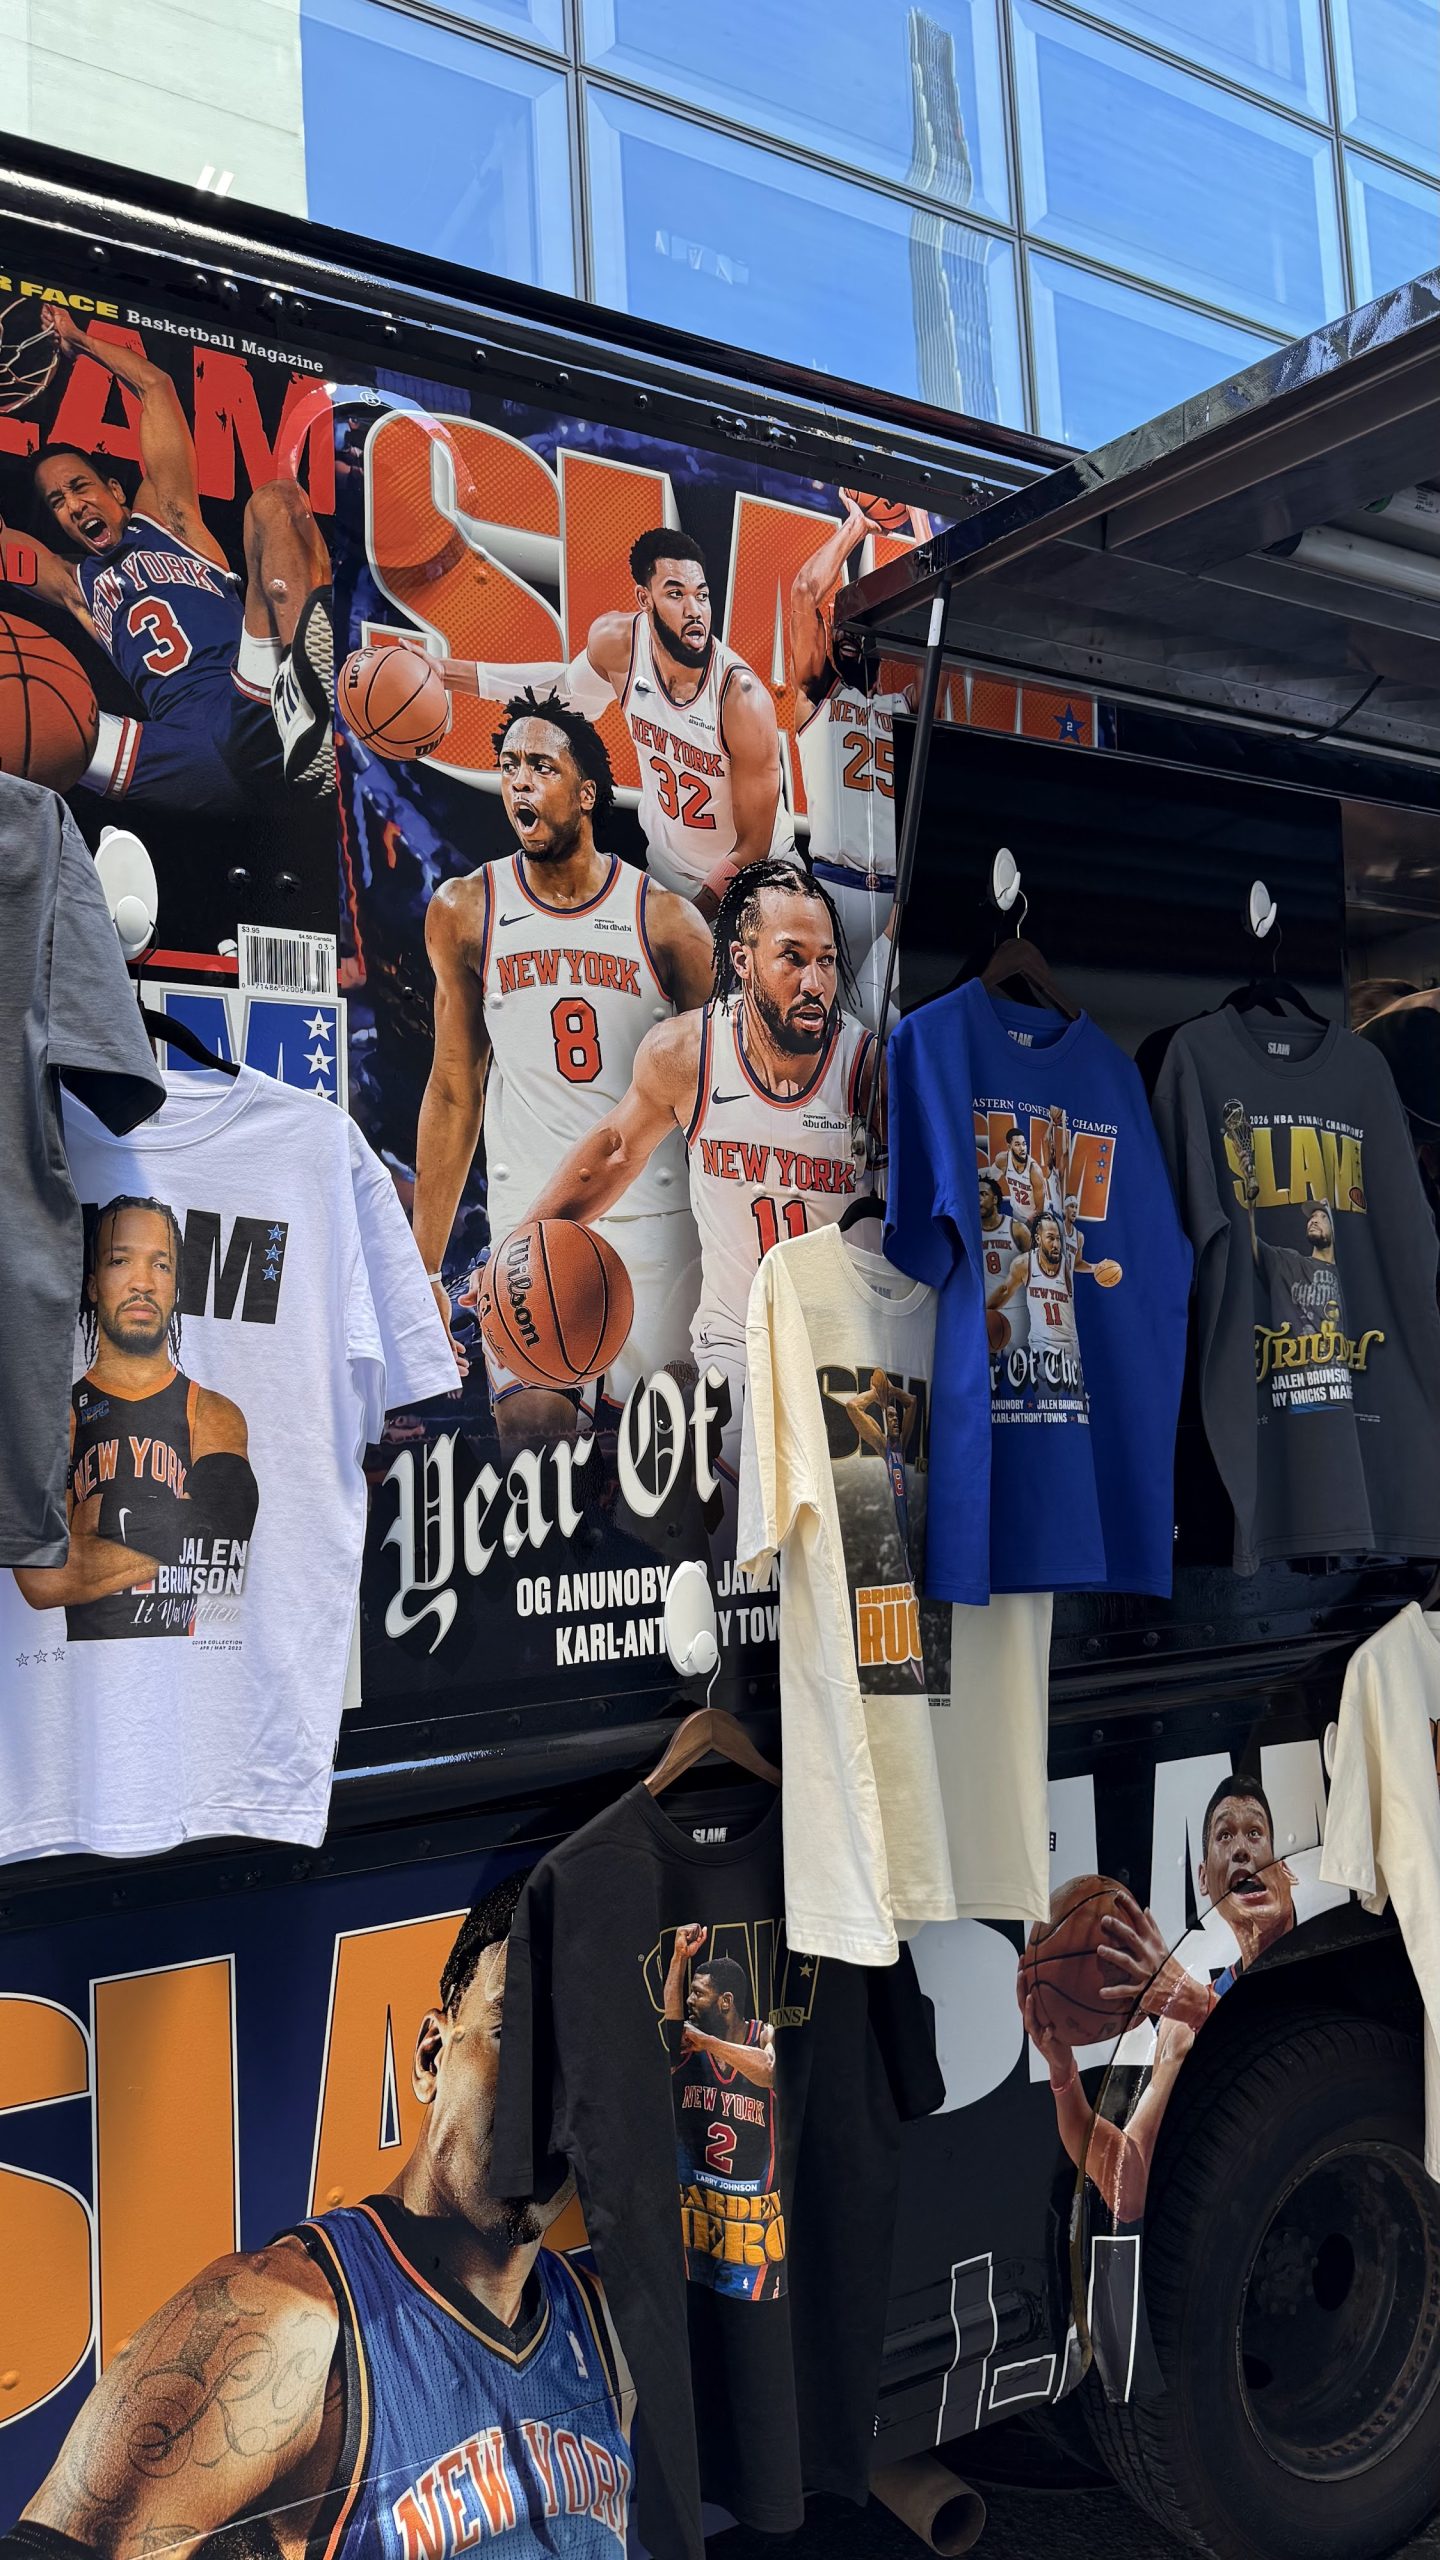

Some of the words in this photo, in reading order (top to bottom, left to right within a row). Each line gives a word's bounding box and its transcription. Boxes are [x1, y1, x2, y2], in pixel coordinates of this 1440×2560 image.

[20, 280, 119, 320] FACE
[126, 308, 236, 350] Basketball
[241, 338, 324, 373] Magazine
[92, 566, 125, 656] NEW
[121, 551, 226, 599] YORK
[127, 595, 193, 677] 3
[828, 699, 873, 727] NEW
[1066, 722, 1073, 732] 2
[630, 713, 669, 756] NEW
[669, 732, 725, 777] YORK
[649, 755, 717, 830] 32
[241, 925, 261, 934] $3.95
[497, 950, 561, 996] NEW
[561, 948, 642, 998] YORK
[550, 997, 603, 1084] 8
[1267, 1042, 1290, 1057] SLAM
[802, 1119, 819, 1128] abu
[820, 1120, 847, 1130] dhabi
[972, 1097, 1014, 1110] ASTERN
[1072, 1118, 1118, 1135] CHAMPS
[1249, 1115, 1269, 1125] 2026
[1273, 1114, 1294, 1124] NBA
[1298, 1115, 1323, 1127] FINALS
[699, 1138, 772, 1184] NEW
[772, 1151, 857, 1194] YORK
[986, 1251, 1002, 1275] 8
[507, 1235, 541, 1349] Wilson
[1043, 1302, 1063, 1326] 11
[1007, 1348, 1038, 1388] Of
[1042, 1346, 1078, 1390] The
[1271, 1375, 1305, 1391] JALEN
[79, 1393, 88, 1407] 6
[991, 1400, 1024, 1410] ANUNOBY
[1037, 1400, 1058, 1410] JALEN
[1271, 1391, 1288, 1408] NY
[1290, 1386, 1327, 1406] KNICKS
[991, 1412, 1042, 1424] KARL-ANTHONY
[1043, 1412, 1067, 1424] TOWNS
[74, 1438, 119, 1504] NEW
[128, 1435, 188, 1499] YORK
[380, 1427, 596, 1655] Year
[617, 1363, 731, 1518] Of
[179, 1537, 249, 1567] JALEN
[158, 1565, 245, 1595] BRUNSON
[516, 1576, 552, 1617] OG
[556, 1565, 670, 1614] ANUNOBY
[857, 1584, 913, 1604] BRING
[130, 1595, 155, 1626] It
[692, 1826, 728, 1844] SLAM
[682, 2085, 717, 2112] NEW
[721, 2091, 766, 2127] YORK
[705, 2121, 737, 2174] 2
[695, 2173, 718, 2188] LARRY
[719, 2180, 758, 2193] JOHNSON
[391, 2426, 517, 2560] NEW
